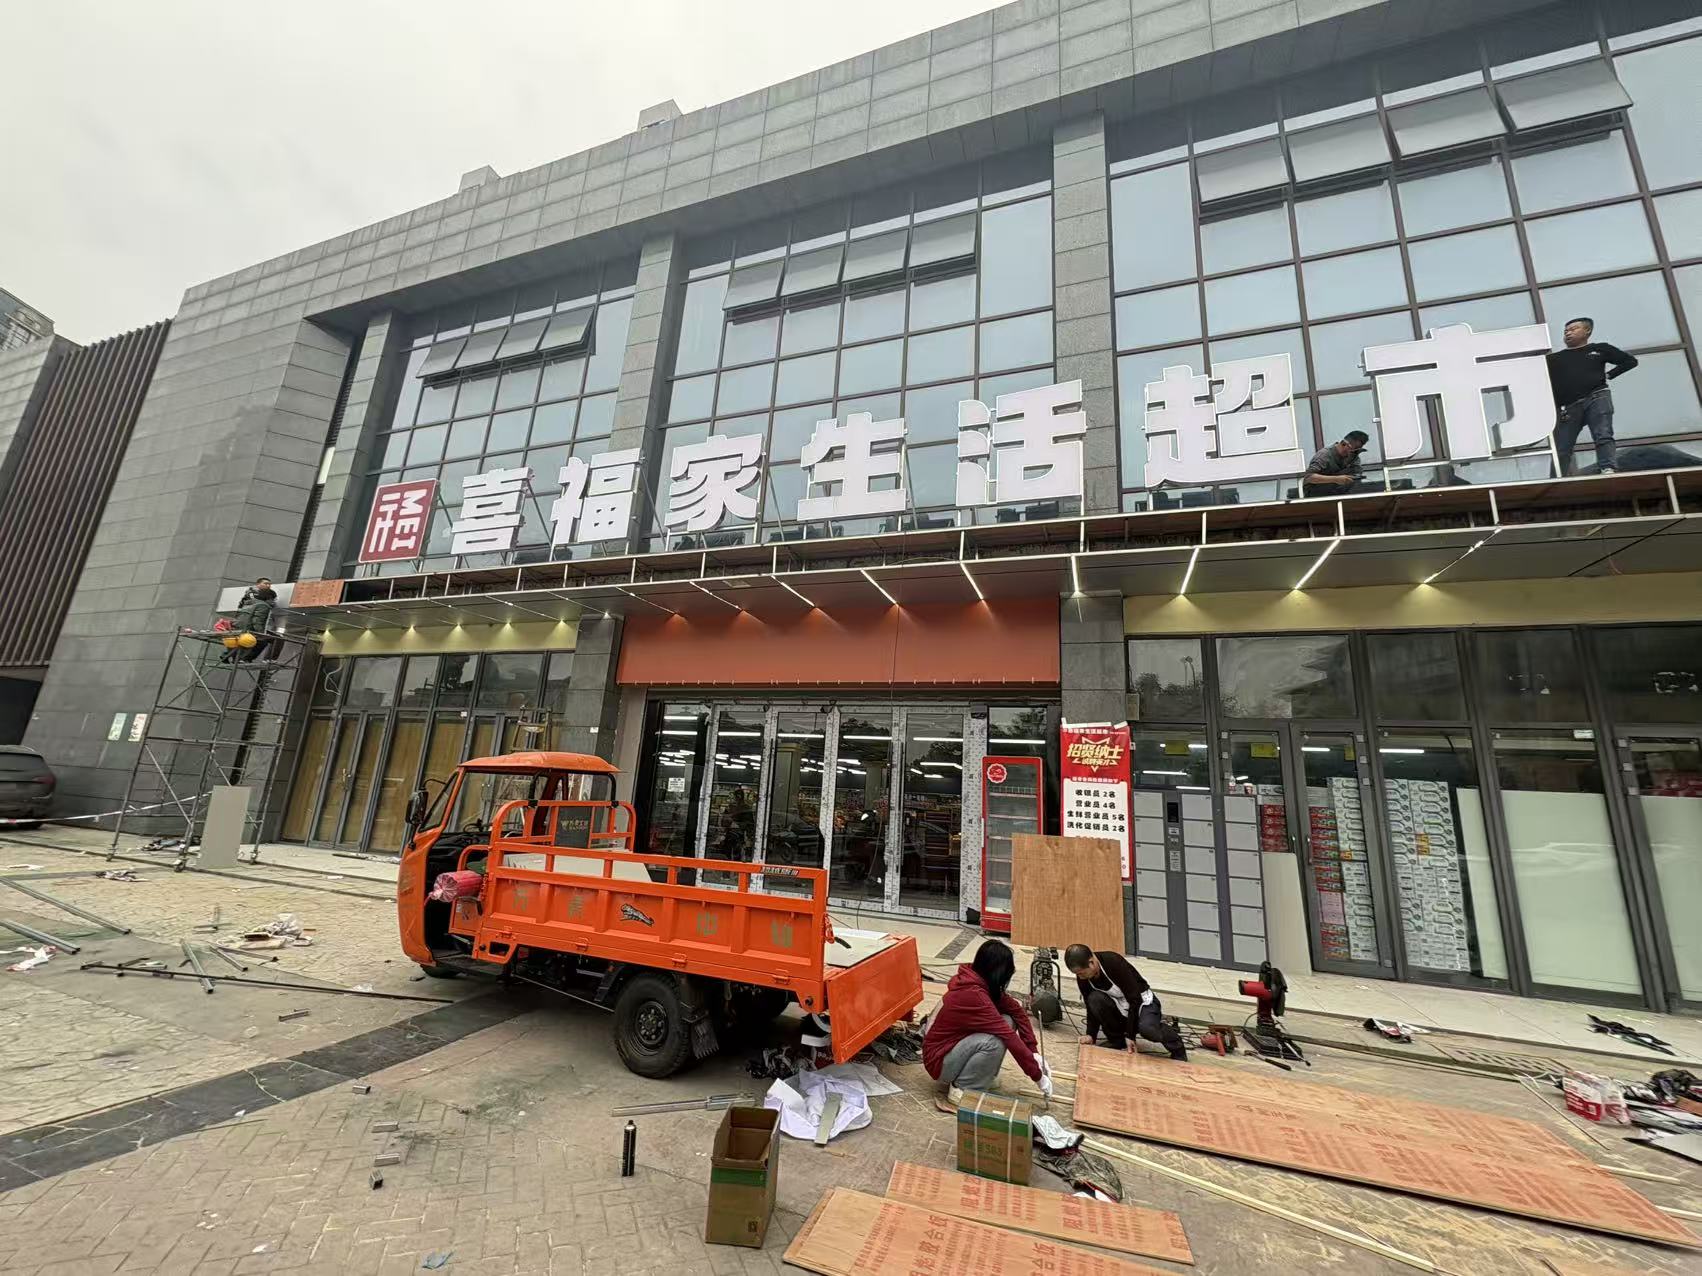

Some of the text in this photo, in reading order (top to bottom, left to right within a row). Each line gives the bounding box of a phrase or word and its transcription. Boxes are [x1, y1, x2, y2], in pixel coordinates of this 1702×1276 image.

[450, 323, 1558, 557] 喜福家生活超市
[1066, 743, 1124, 759] 招贤纳士
